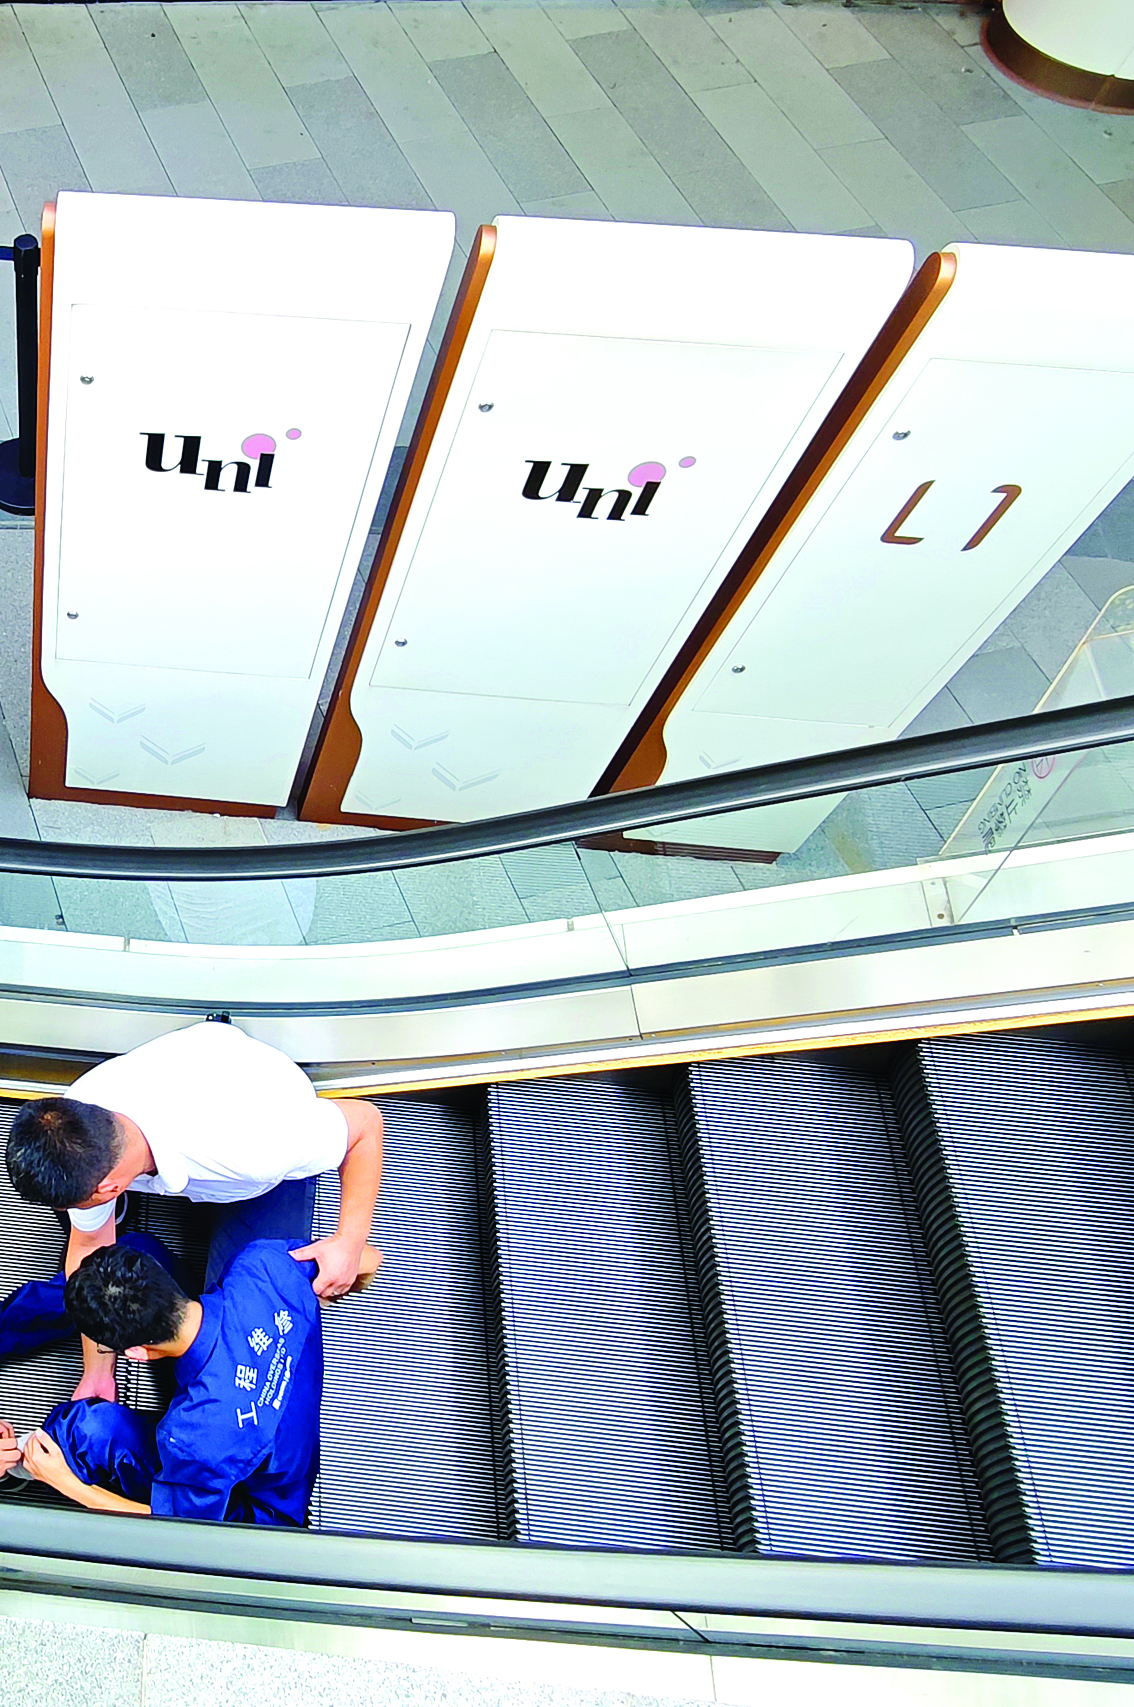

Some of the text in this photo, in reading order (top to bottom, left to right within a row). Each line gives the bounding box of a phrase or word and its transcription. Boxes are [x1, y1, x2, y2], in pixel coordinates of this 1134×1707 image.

[235, 1310, 294, 1428] 工程维修
[257, 1382, 271, 1407] CHINA
